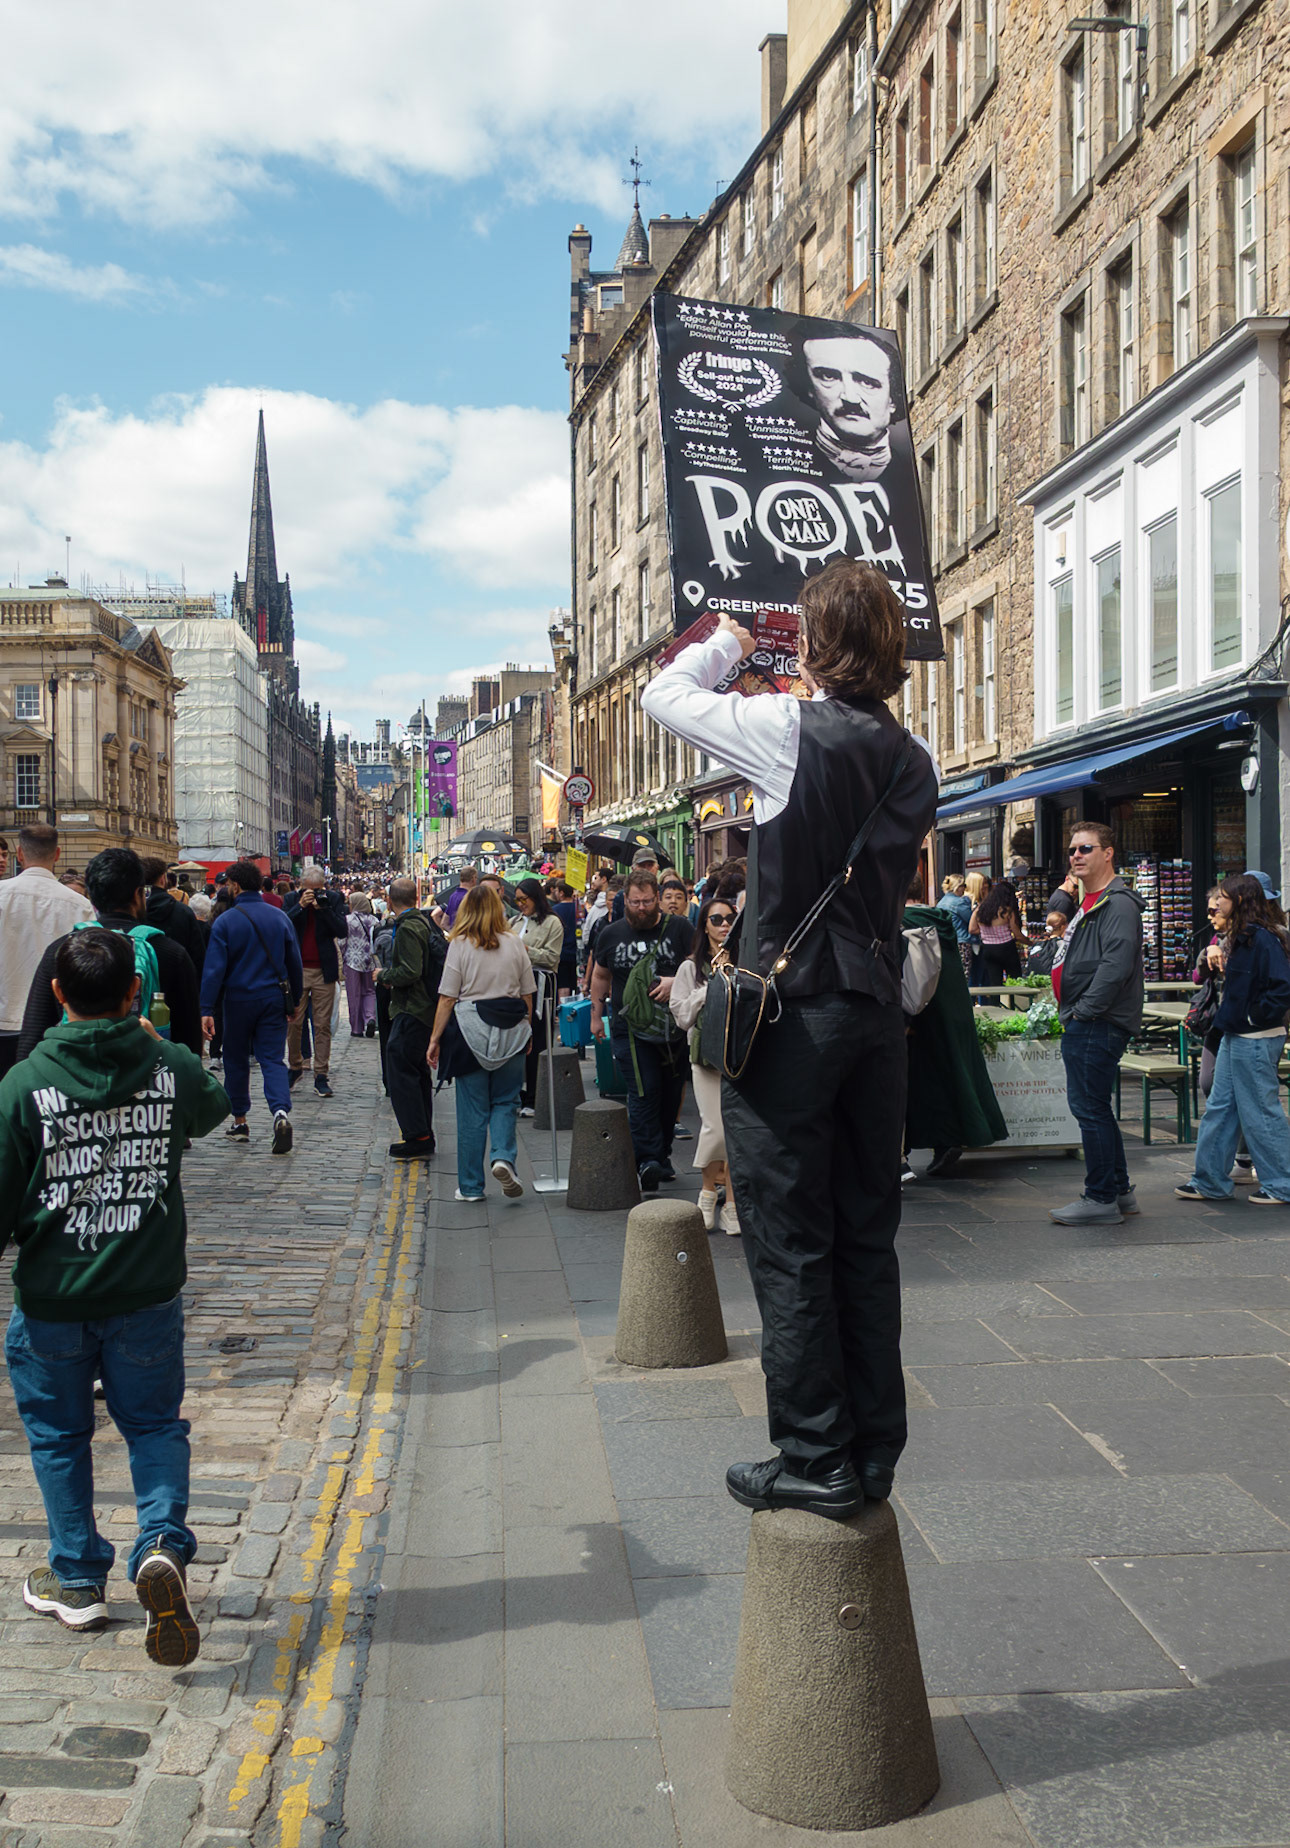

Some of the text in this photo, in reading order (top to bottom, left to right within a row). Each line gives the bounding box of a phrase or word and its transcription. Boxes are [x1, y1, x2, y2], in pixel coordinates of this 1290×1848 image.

[684, 322, 786, 342] himself would love this
[709, 319, 732, 329] Allan
[734, 322, 752, 331] Poe
[689, 331, 792, 349] powerful performance"
[705, 351, 752, 373] fringe
[697, 370, 762, 385] Sell-out show
[716, 381, 744, 392] 2024
[670, 415, 732, 431] "Captivating"
[679, 425, 711, 436] Broadway
[712, 430, 730, 438] Baby
[752, 433, 788, 442] Everything
[789, 436, 813, 445] Theatre
[680, 449, 742, 465] "Compelling"
[763, 455, 814, 468] "Terrifying"
[793, 467, 809, 475] West
[810, 469, 823, 477] End
[774, 497, 821, 522] ONE
[685, 475, 906, 581] POE
[780, 521, 832, 544] MAN
[1021, 1050, 1050, 1061] WINE
[45, 1137, 170, 1179] NAXOS GREECE
[38, 1181, 68, 1211] +30
[64, 1206, 90, 1234] 24
